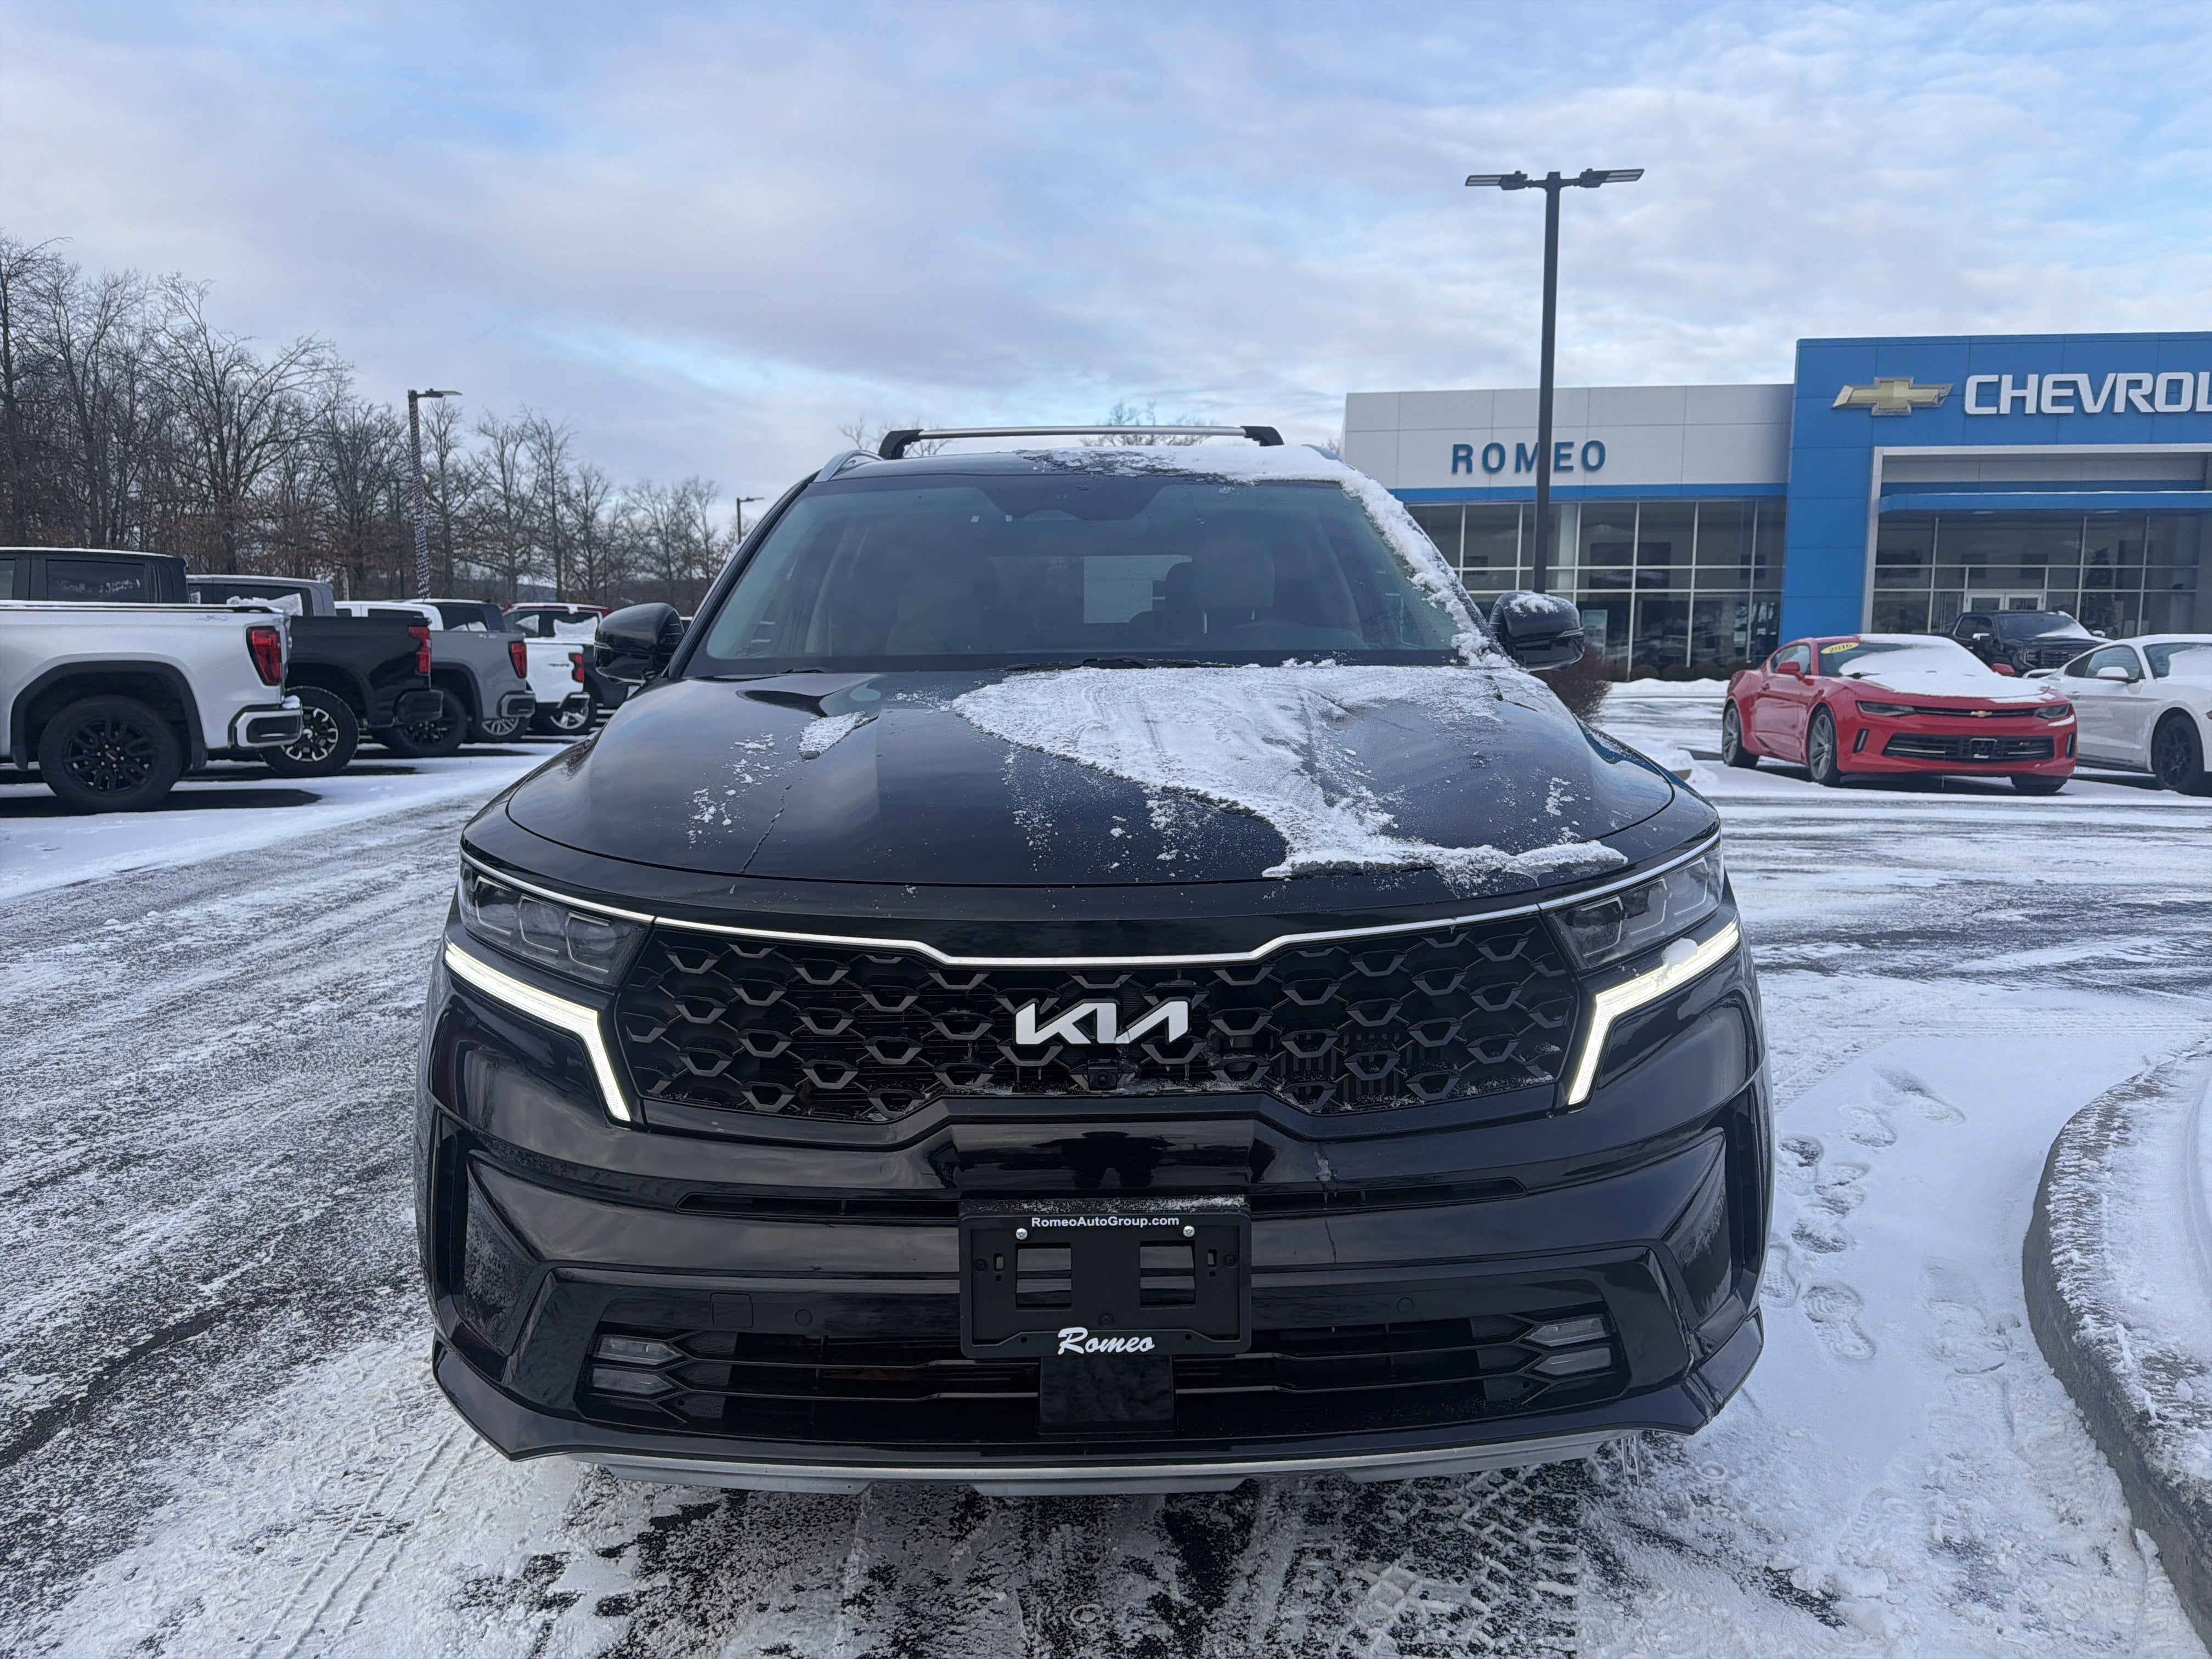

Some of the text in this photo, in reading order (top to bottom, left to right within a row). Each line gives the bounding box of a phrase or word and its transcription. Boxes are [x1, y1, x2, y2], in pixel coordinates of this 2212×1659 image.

[1452, 440, 1606, 474] ROMEO
[1015, 1001, 1189, 1045] KIA
[1031, 1216, 1180, 1228] RomeoAutoGroup.com
[1057, 1327, 1155, 1355] Romeo
